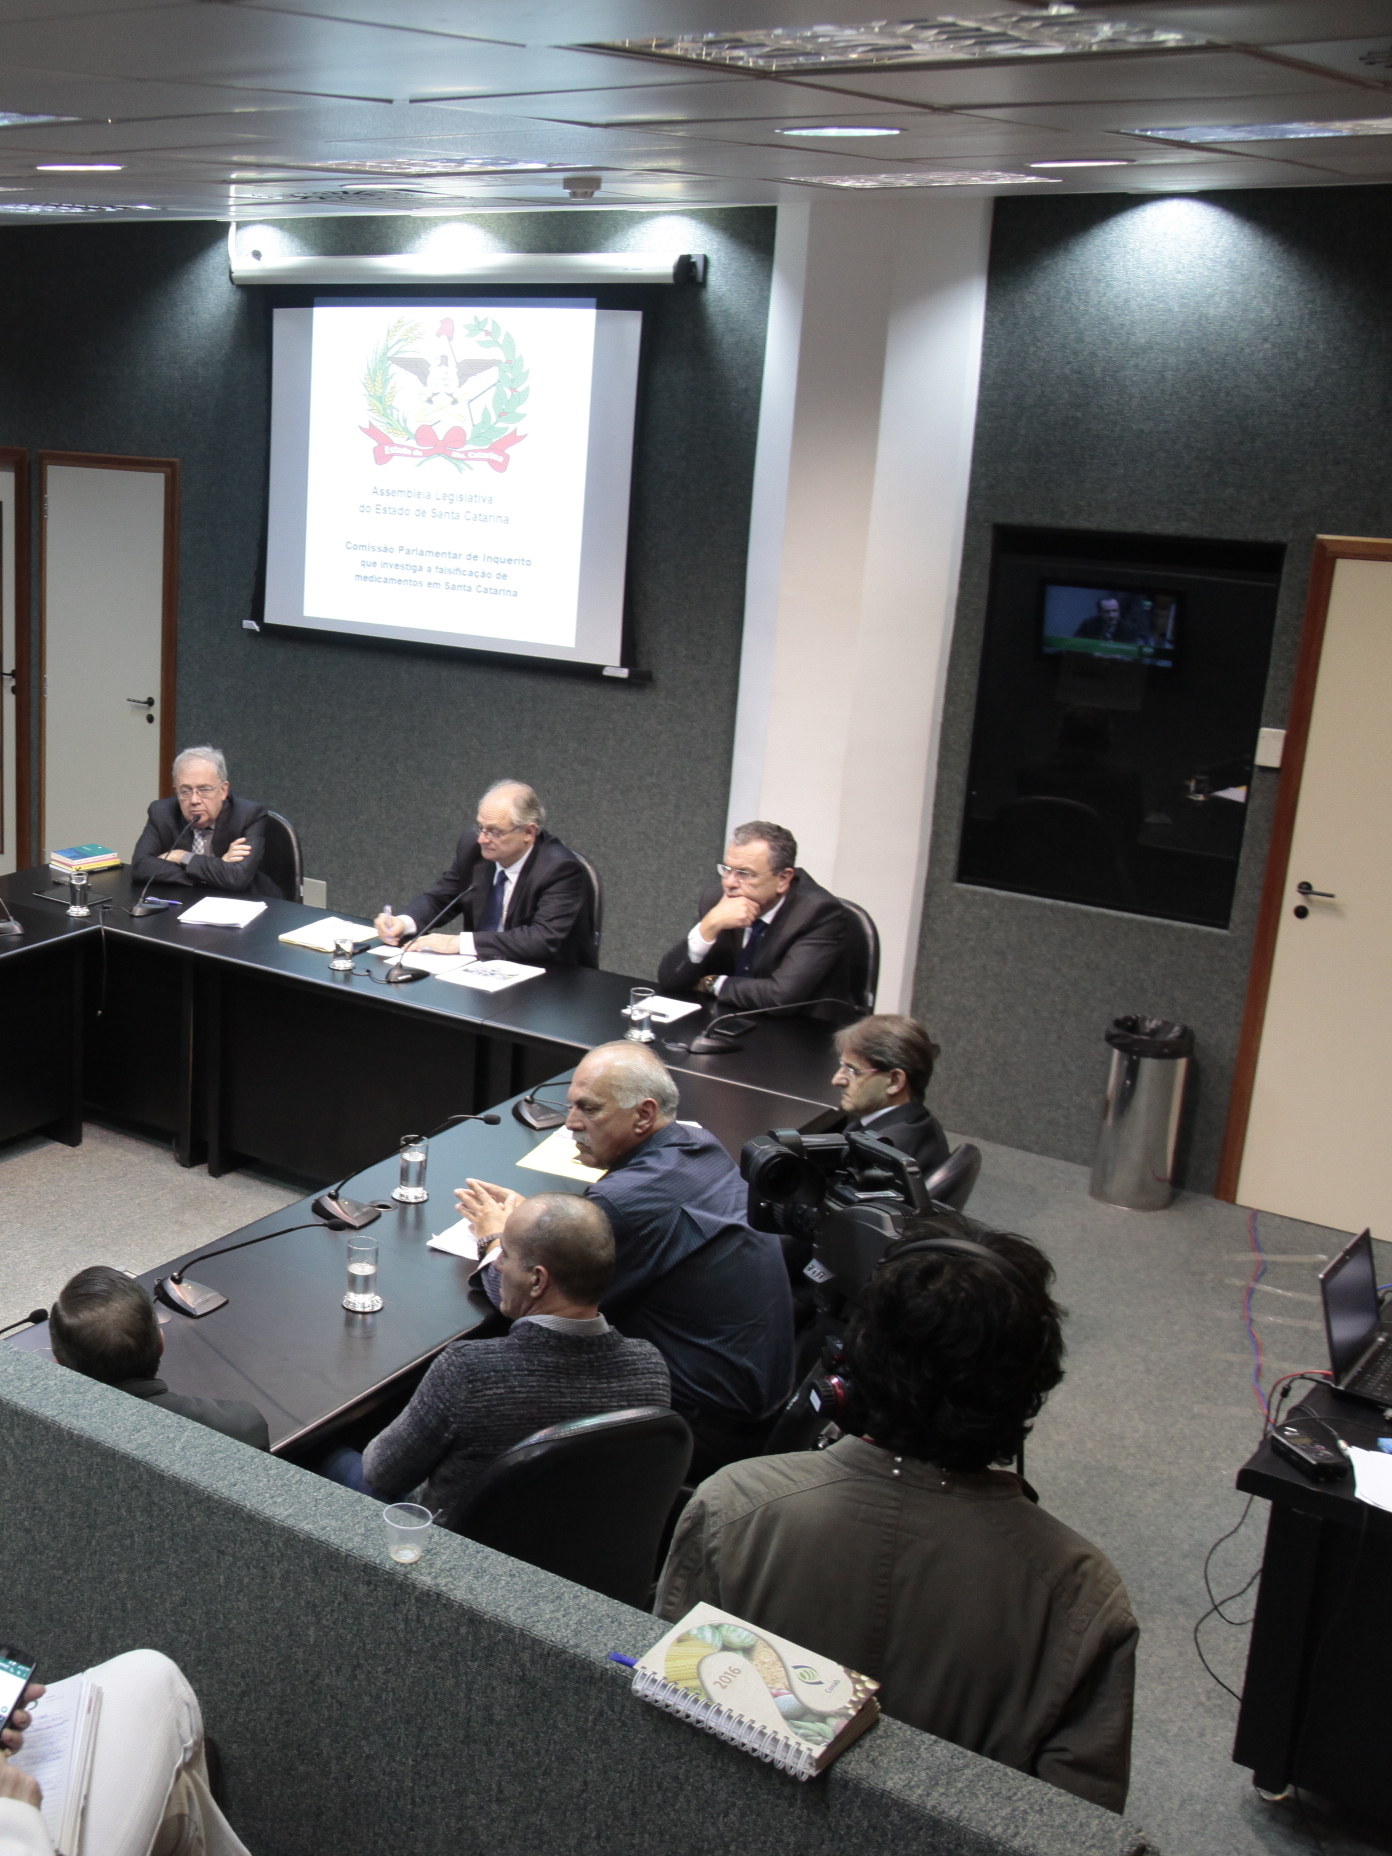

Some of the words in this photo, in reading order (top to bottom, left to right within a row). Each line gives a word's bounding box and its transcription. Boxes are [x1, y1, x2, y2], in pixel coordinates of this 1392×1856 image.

[371, 486, 431, 500] Assembleia
[435, 490, 493, 505] Legislativa
[359, 503, 372, 513] do
[375, 504, 411, 517] Estado
[414, 507, 427, 517] de
[431, 508, 460, 520] Santa
[464, 511, 509, 525] Catarina
[345, 541, 395, 554] Comissão
[398, 545, 463, 560] Parlamentar
[466, 552, 479, 562] de
[360, 559, 378, 569] que
[380, 560, 423, 574] investiga
[426, 565, 432, 573] a
[435, 565, 493, 579] falsificação
[495, 571, 508, 581] de
[354, 573, 424, 588] medicamentos
[426, 580, 441, 589] em
[444, 581, 473, 593] Santa
[475, 584, 519, 598] Catarina
[713, 1665, 742, 1690] 2016
